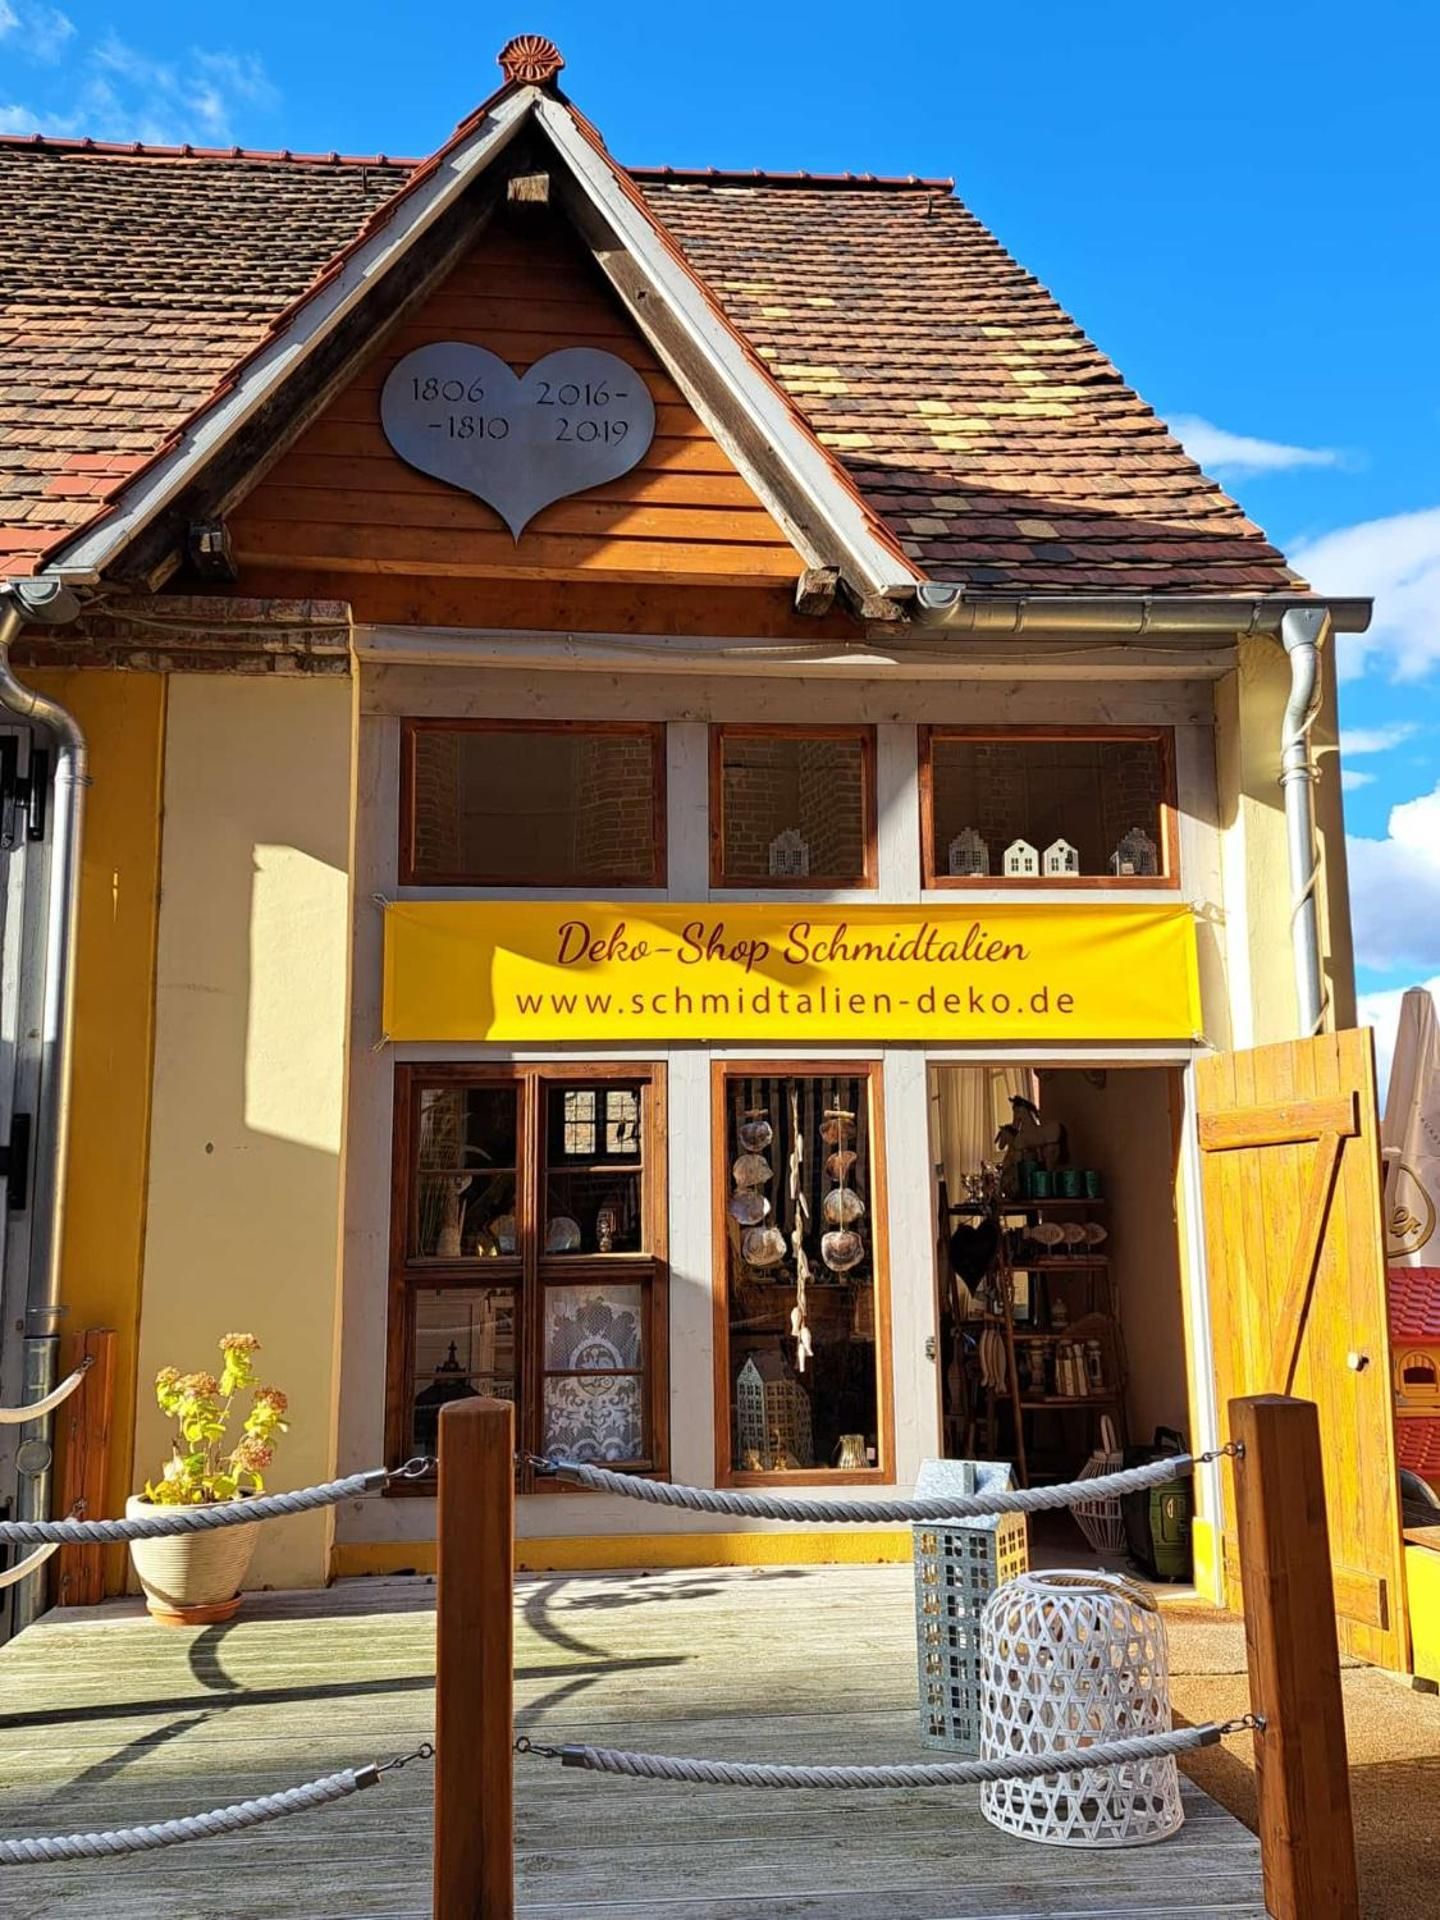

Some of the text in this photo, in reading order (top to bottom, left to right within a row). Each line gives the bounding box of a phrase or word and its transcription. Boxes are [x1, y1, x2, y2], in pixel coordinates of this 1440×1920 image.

[411, 377, 485, 403] 1806
[535, 379, 629, 406] 2016-
[428, 415, 510, 440] -1810
[555, 418, 629, 447] 2019
[557, 920, 1032, 974] Deko-Shop Schmidtalien
[515, 984, 1075, 1014] www.schmidtalien-deko.de
